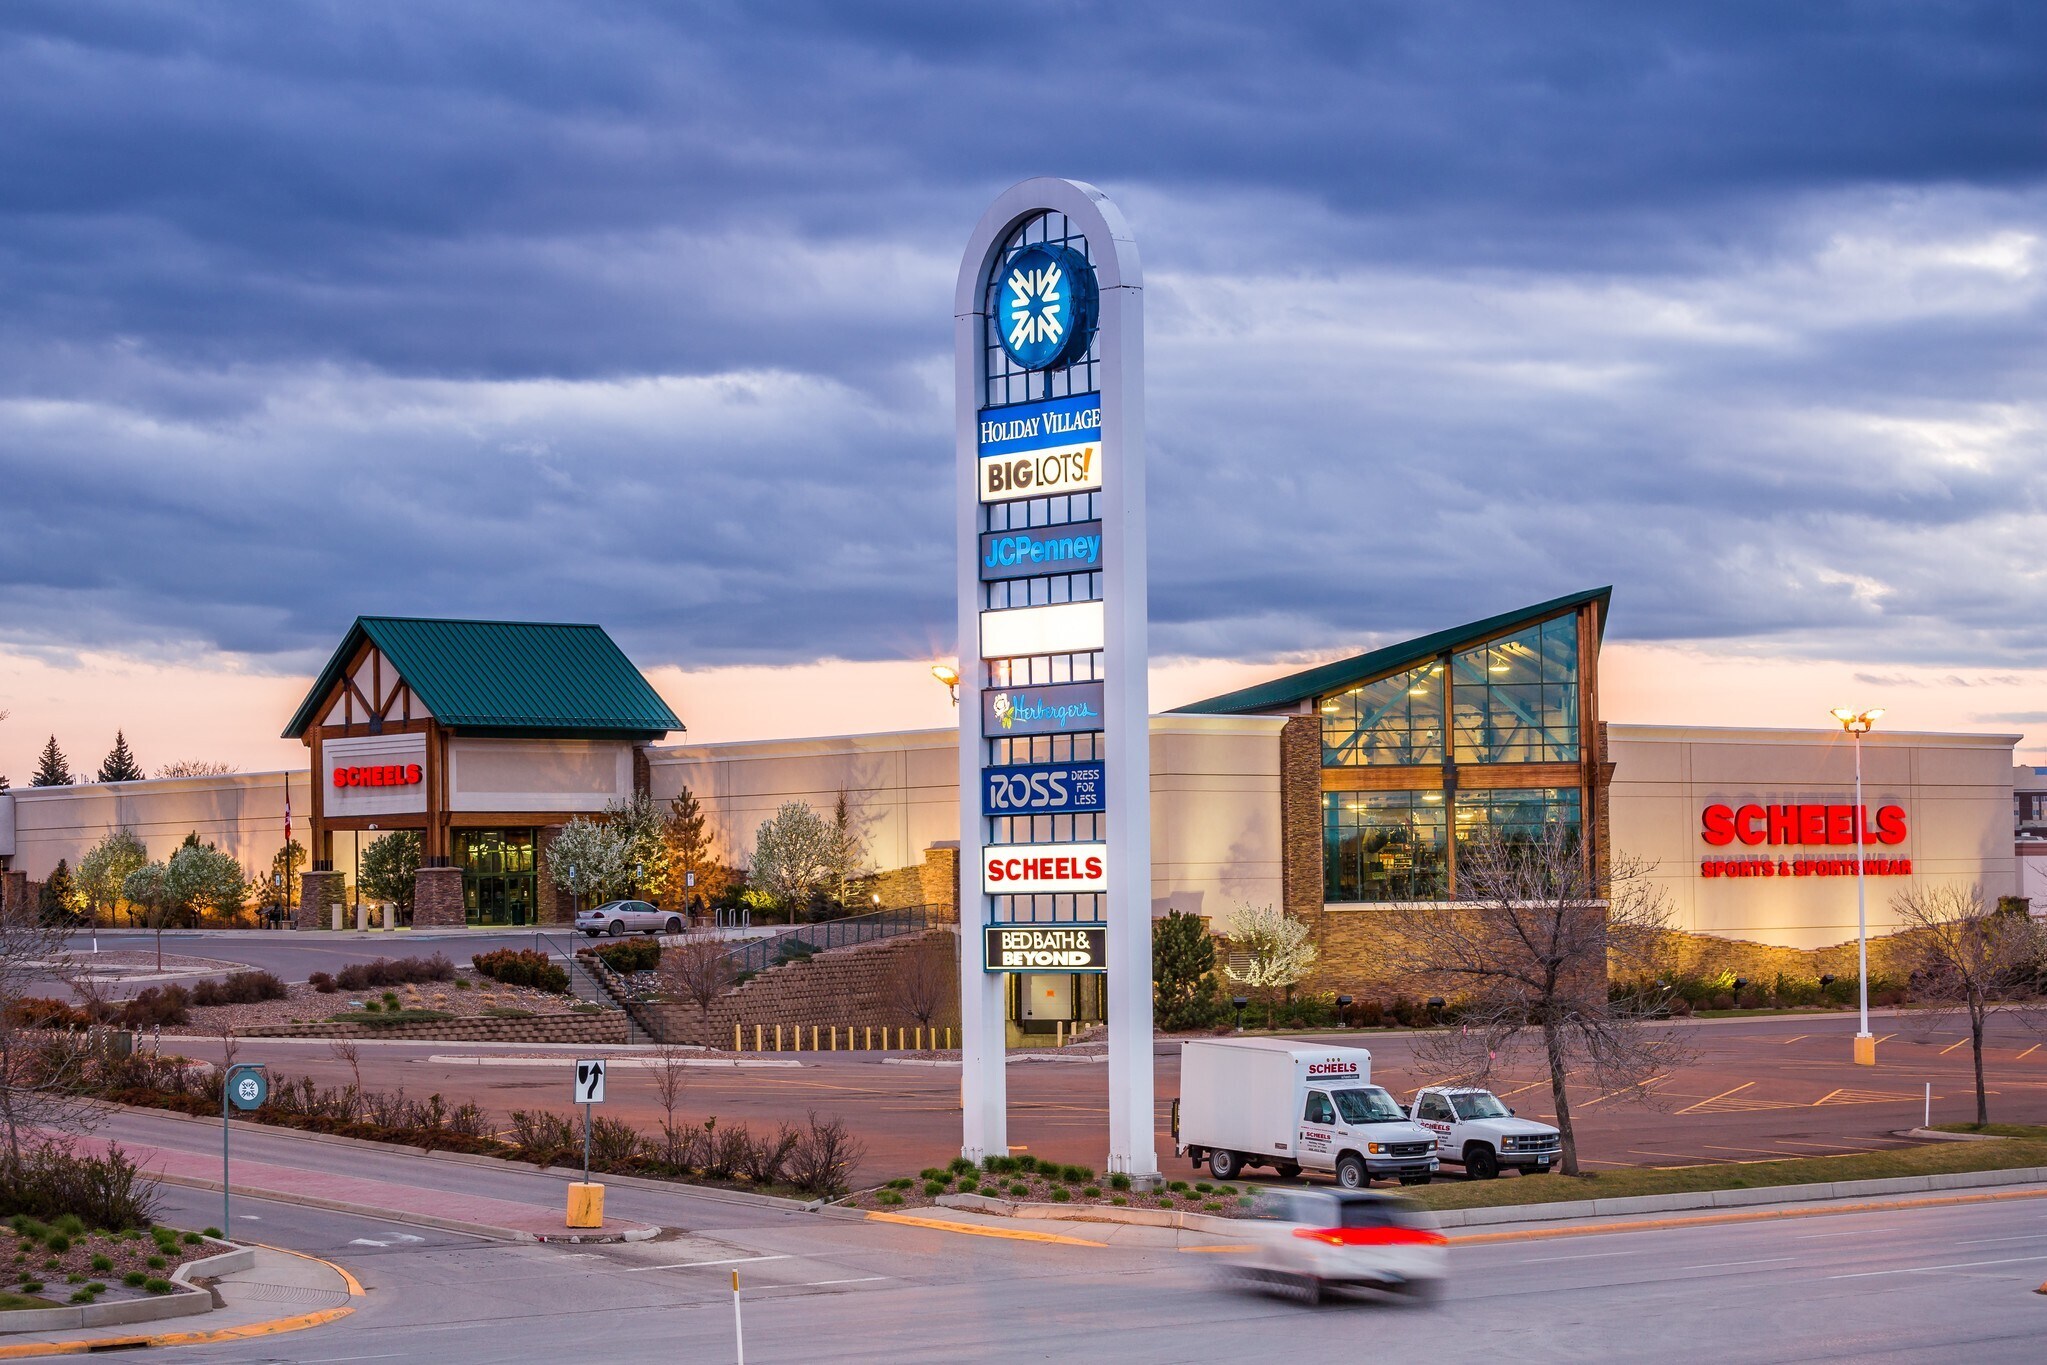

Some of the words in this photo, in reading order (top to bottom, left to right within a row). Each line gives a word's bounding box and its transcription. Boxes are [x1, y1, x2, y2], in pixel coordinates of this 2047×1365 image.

[981, 417, 1041, 444] HOLIDAY
[1042, 408, 1101, 434] VILLAGE
[988, 459, 1033, 493] BIG
[1036, 447, 1093, 486] LOTS!
[985, 535, 1101, 568] JCPenney
[1012, 694, 1097, 728] Herberger's
[333, 764, 423, 787] SCHEELS
[1071, 769, 1100, 781] DRESS
[990, 771, 1068, 809] ROSS
[1076, 782, 1094, 793] FOR
[1074, 794, 1097, 805] LESS
[1701, 804, 1907, 846] SCHEELS
[988, 856, 1103, 882] SCHEELS
[1701, 860, 1775, 878] SPORTS
[1778, 860, 1790, 877] &
[1002, 932, 1032, 950] BED
[1034, 931, 1075, 949] BATH
[1076, 931, 1091, 949] &
[1002, 951, 1091, 966] BEYOND
[1309, 1063, 1357, 1074] SCHEELS
[1306, 1132, 1331, 1140] SCHEELS
